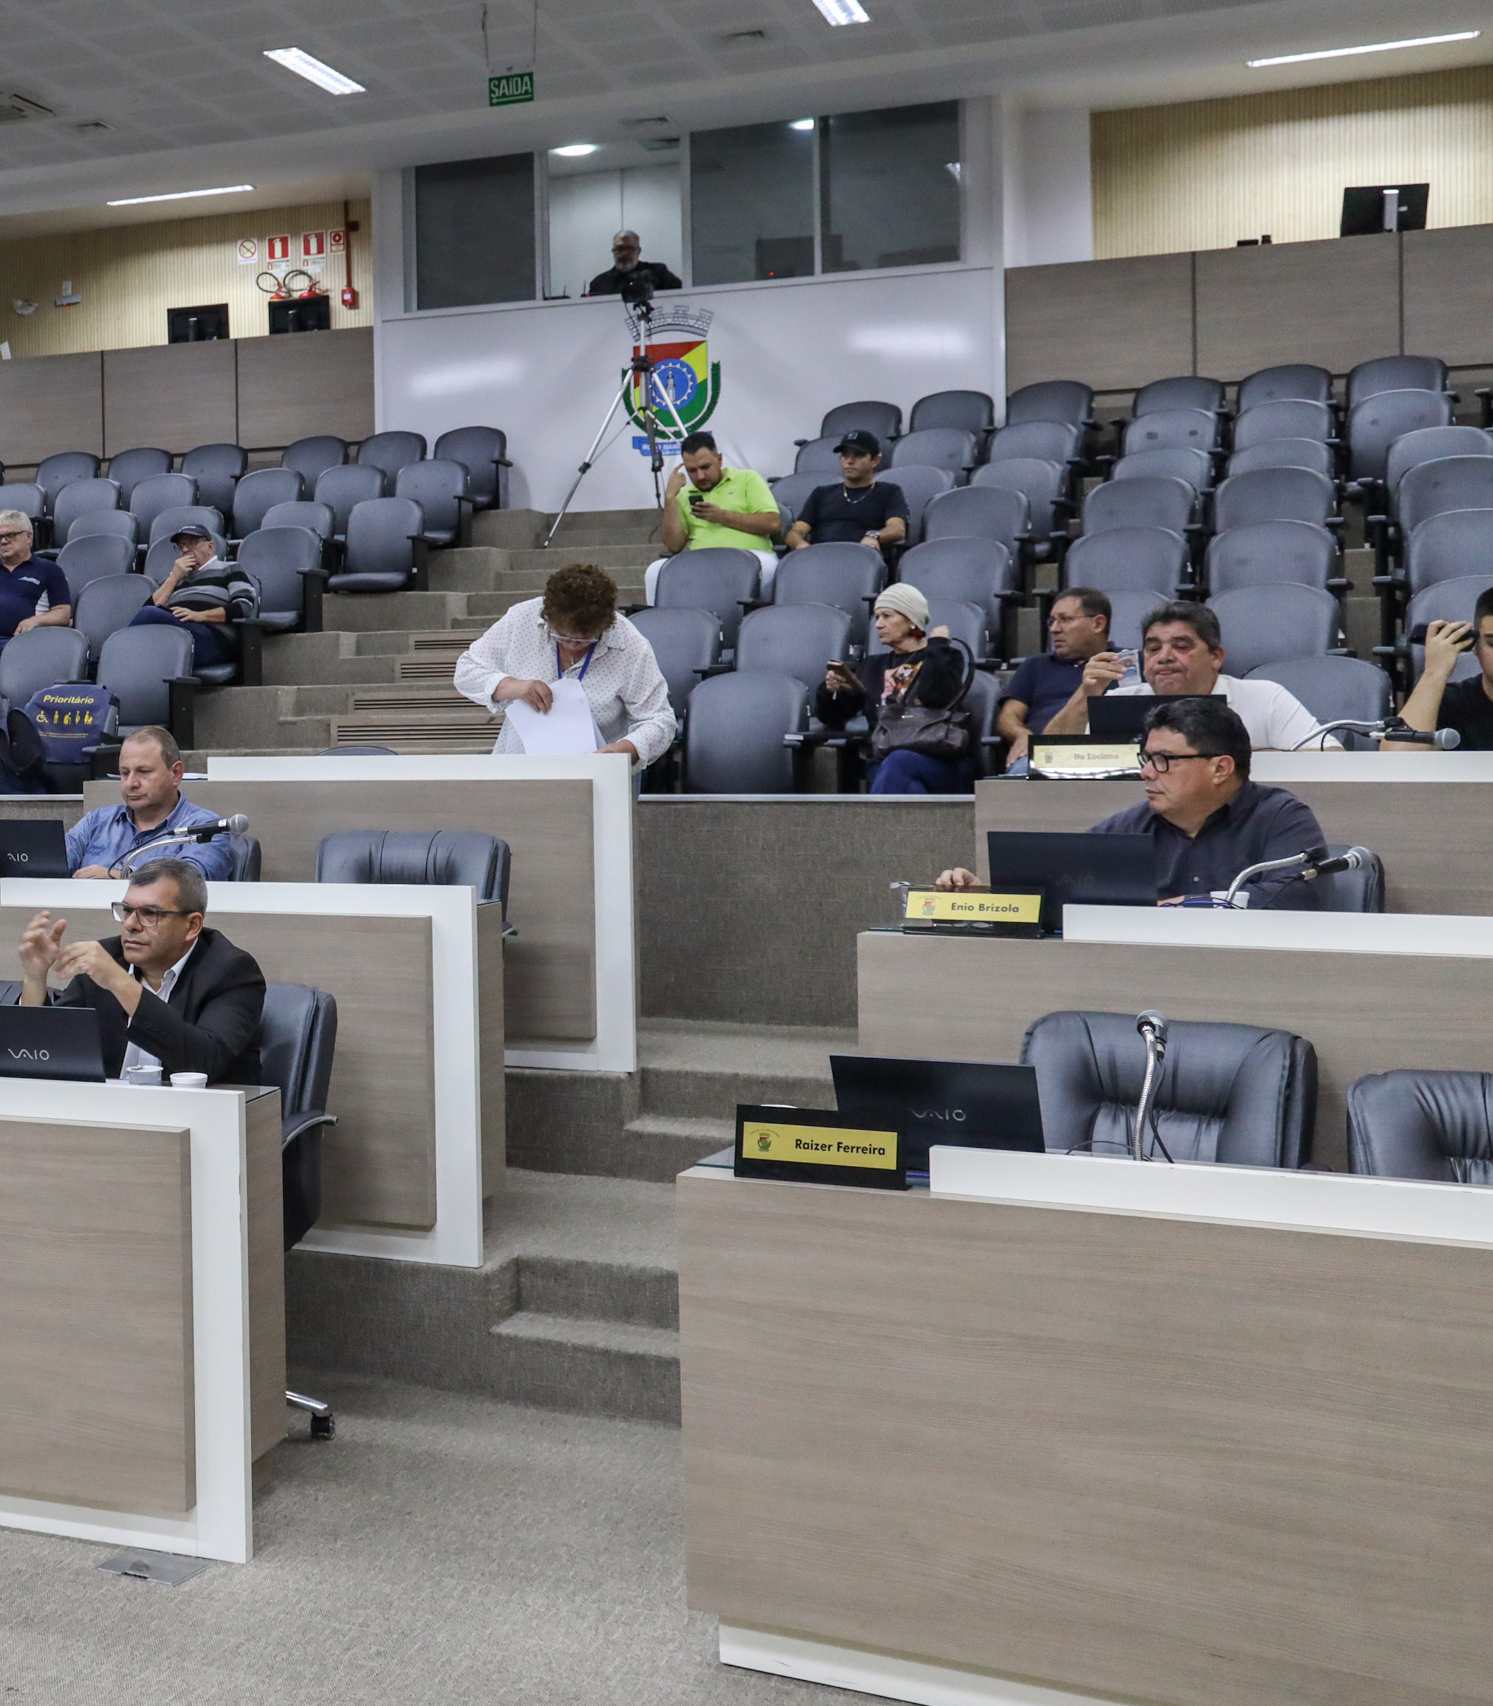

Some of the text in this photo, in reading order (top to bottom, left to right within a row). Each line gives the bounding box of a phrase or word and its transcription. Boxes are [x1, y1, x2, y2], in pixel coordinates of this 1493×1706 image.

[490, 76, 532, 97] SAÍDA
[43, 694, 95, 704] Prioritário
[951, 902, 1020, 913] Enio Brizola
[8, 1048, 50, 1061] VAIO
[794, 1138, 886, 1156] Raizer Ferreira
